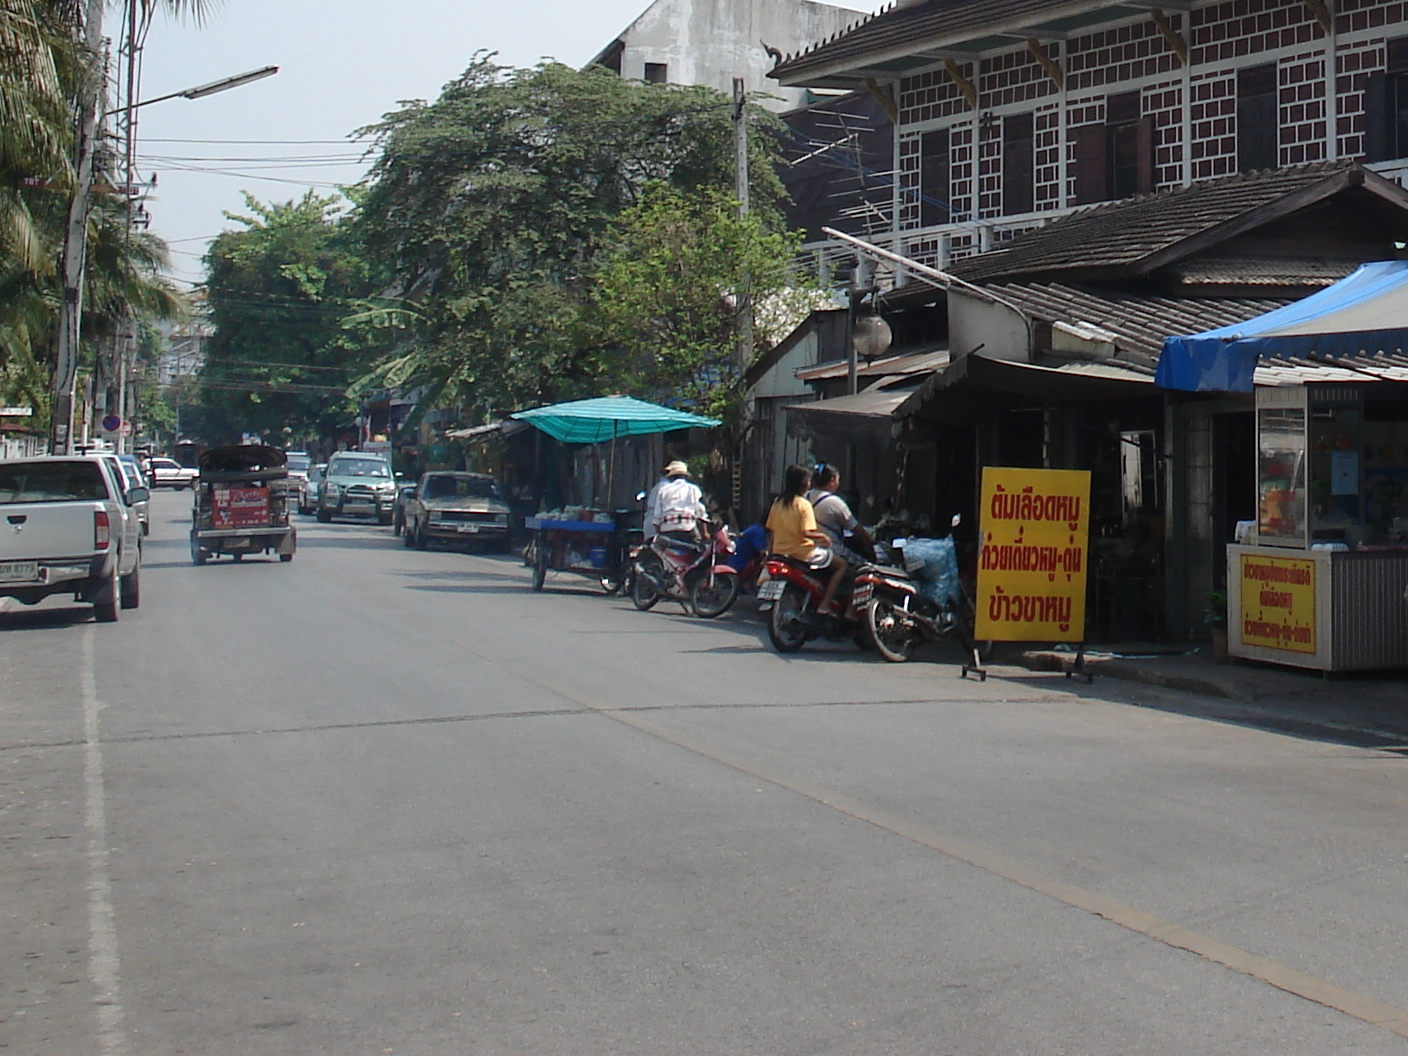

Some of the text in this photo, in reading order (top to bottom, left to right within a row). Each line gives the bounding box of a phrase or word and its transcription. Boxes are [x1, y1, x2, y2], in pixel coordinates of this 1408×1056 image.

[990, 484, 1081, 532] ต้มเลือดหมู
[988, 585, 1072, 633] ข้าวขาหมู
